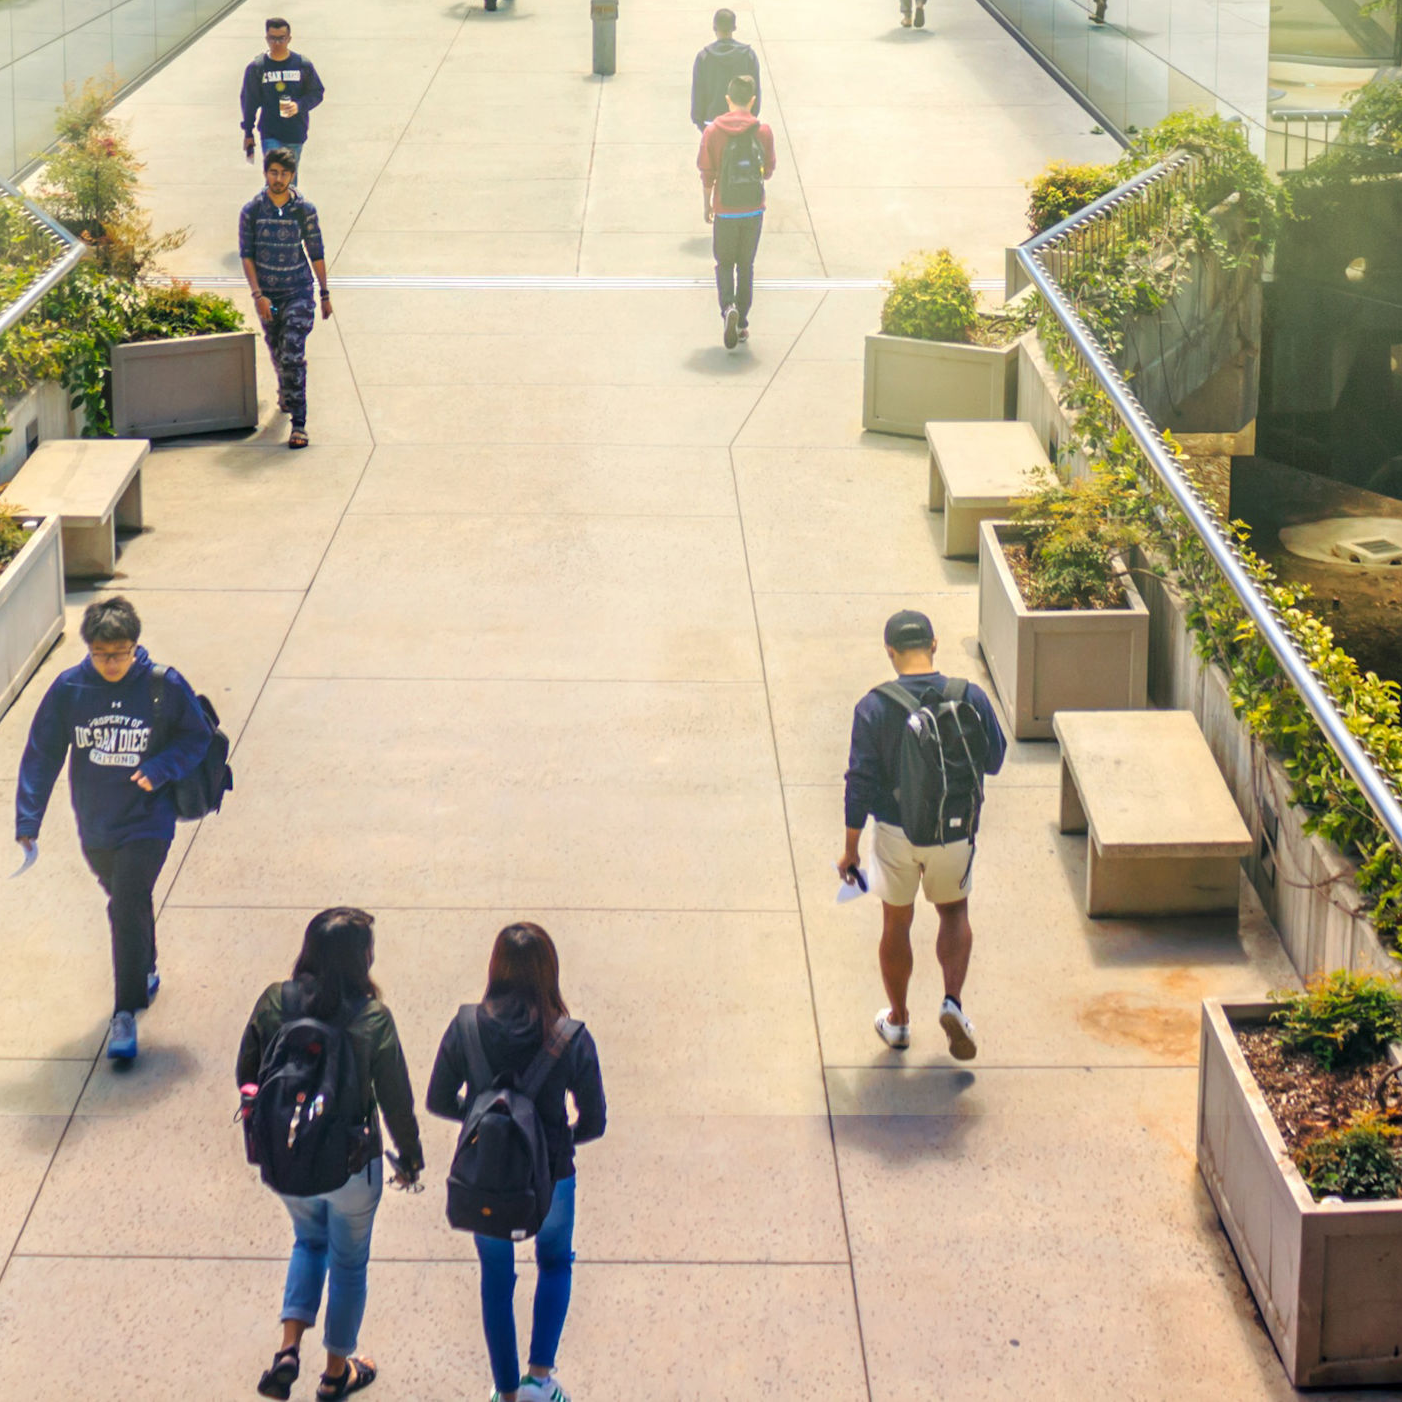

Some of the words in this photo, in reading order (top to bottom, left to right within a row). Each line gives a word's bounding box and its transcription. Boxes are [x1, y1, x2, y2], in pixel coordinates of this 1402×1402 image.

[88, 715, 132, 728] PROPERTY
[131, 719, 144, 728] OF
[75, 725, 94, 749] UC
[93, 727, 118, 752] SAN
[118, 727, 151, 752] DIEG
[93, 752, 135, 764] TRITONS
